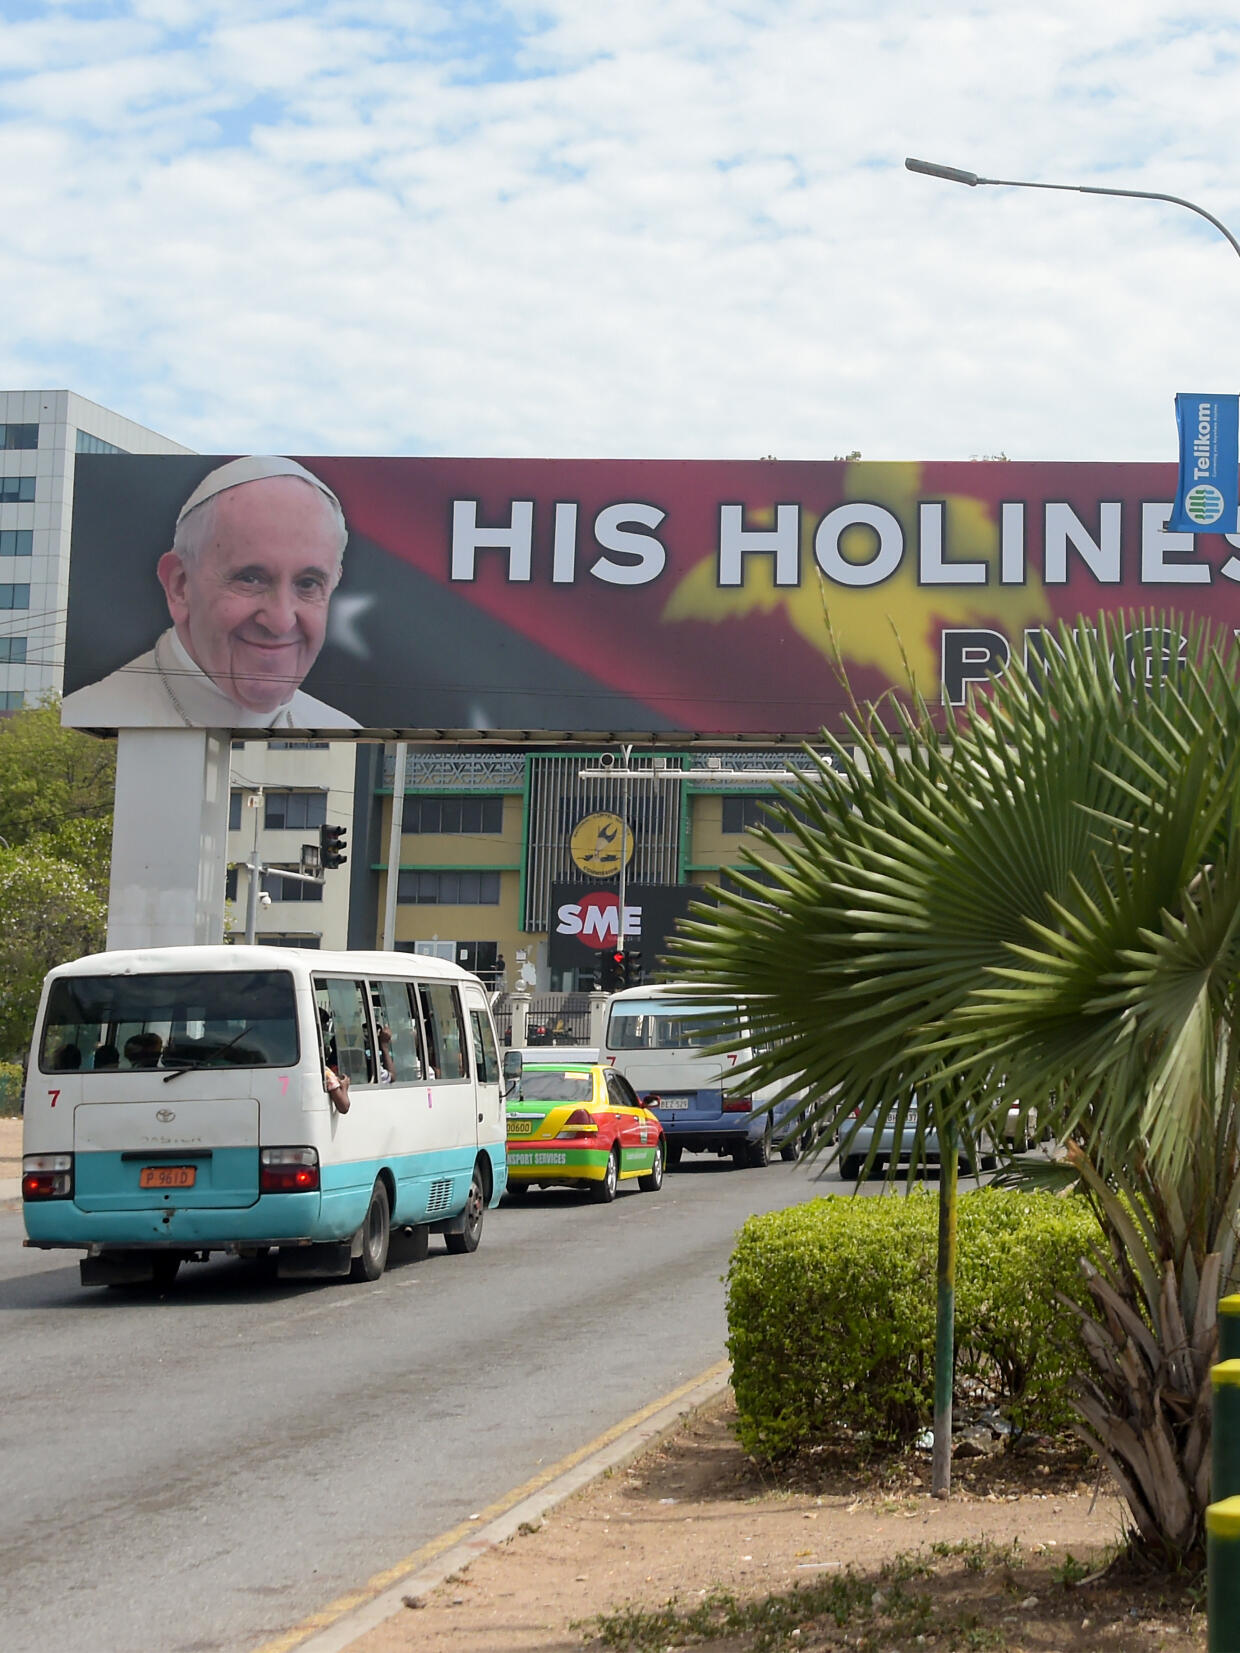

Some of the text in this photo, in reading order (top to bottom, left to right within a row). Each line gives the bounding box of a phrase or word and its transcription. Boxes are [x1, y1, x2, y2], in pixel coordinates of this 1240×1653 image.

[1193, 403, 1210, 480] Telikom
[451, 500, 667, 585] HIS
[556, 904, 642, 942] SME
[606, 1056, 616, 1066] 7
[727, 1055, 738, 1066] 7
[277, 1076, 289, 1096] 7
[47, 1090, 61, 1107] 7
[535, 1153, 566, 1165] SERVICES
